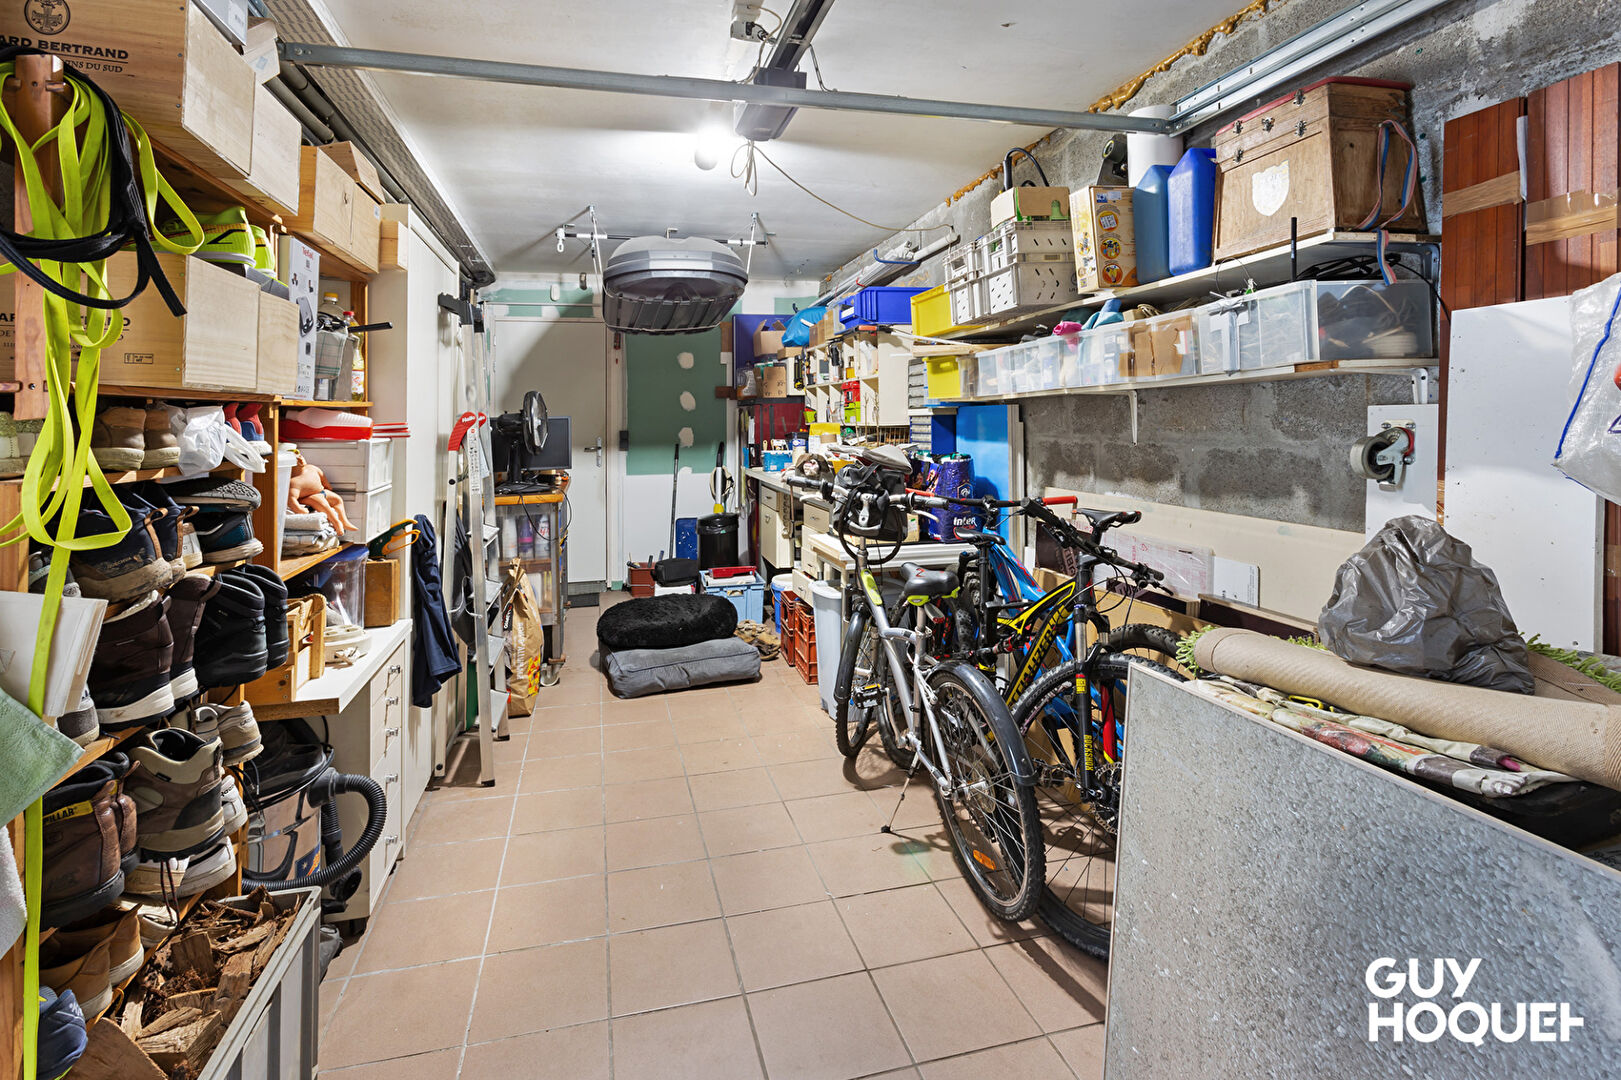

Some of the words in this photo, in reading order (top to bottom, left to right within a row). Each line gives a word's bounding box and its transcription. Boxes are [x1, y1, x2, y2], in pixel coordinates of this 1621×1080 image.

[38, 39, 129, 60] BERTRAND
[86, 61, 101, 70] DU
[103, 64, 123, 73] SUD
[1083, 734, 1094, 771] ROCKSHOX
